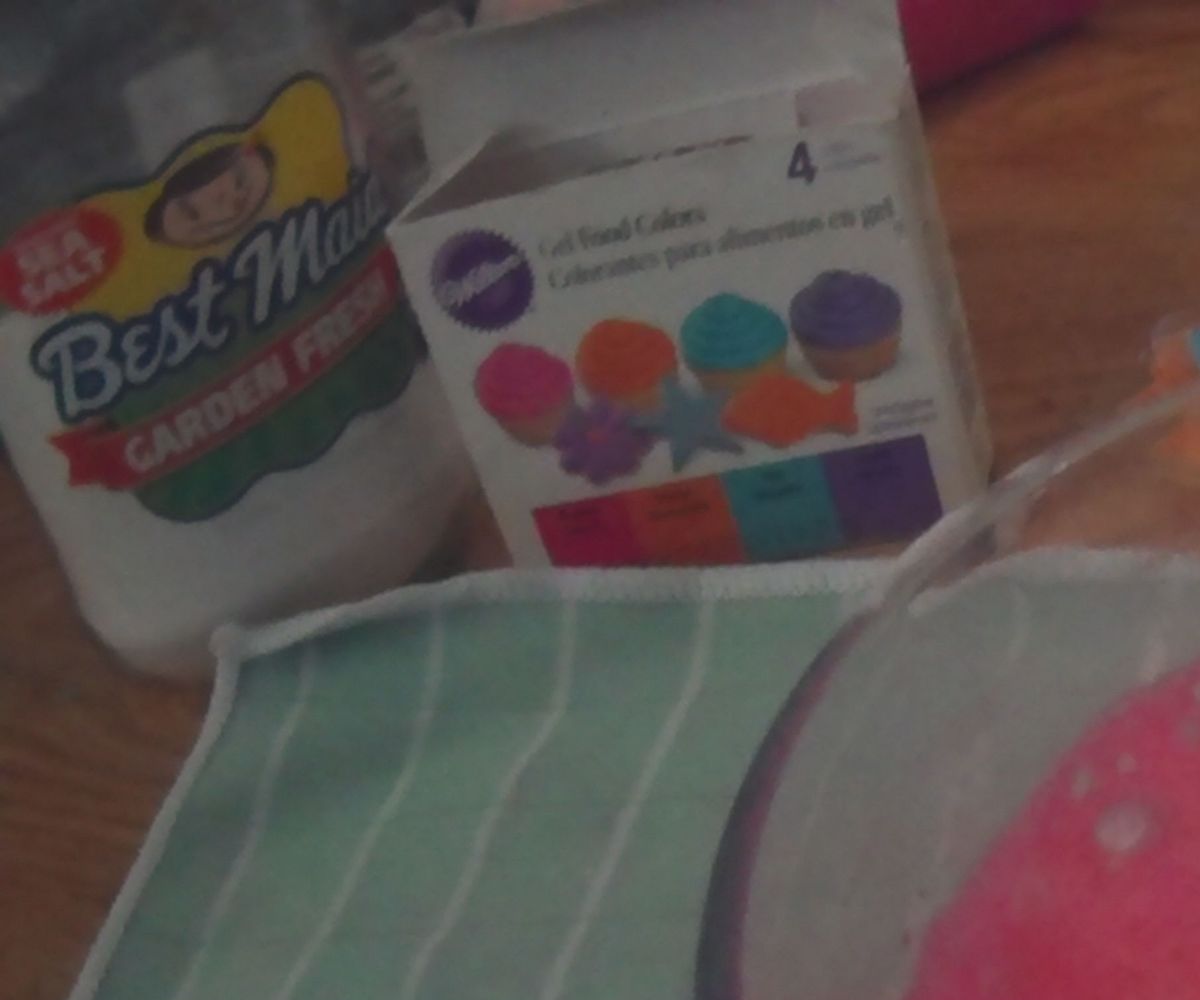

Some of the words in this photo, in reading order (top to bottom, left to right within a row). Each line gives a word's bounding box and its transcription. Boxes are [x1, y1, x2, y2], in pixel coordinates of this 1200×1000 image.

[786, 140, 818, 185] 4
[16, 226, 92, 277] SEA
[20, 247, 107, 304] SALT
[36, 264, 231, 417] Best
[123, 352, 289, 472] GARDEN
[289, 265, 389, 373] FRESH
